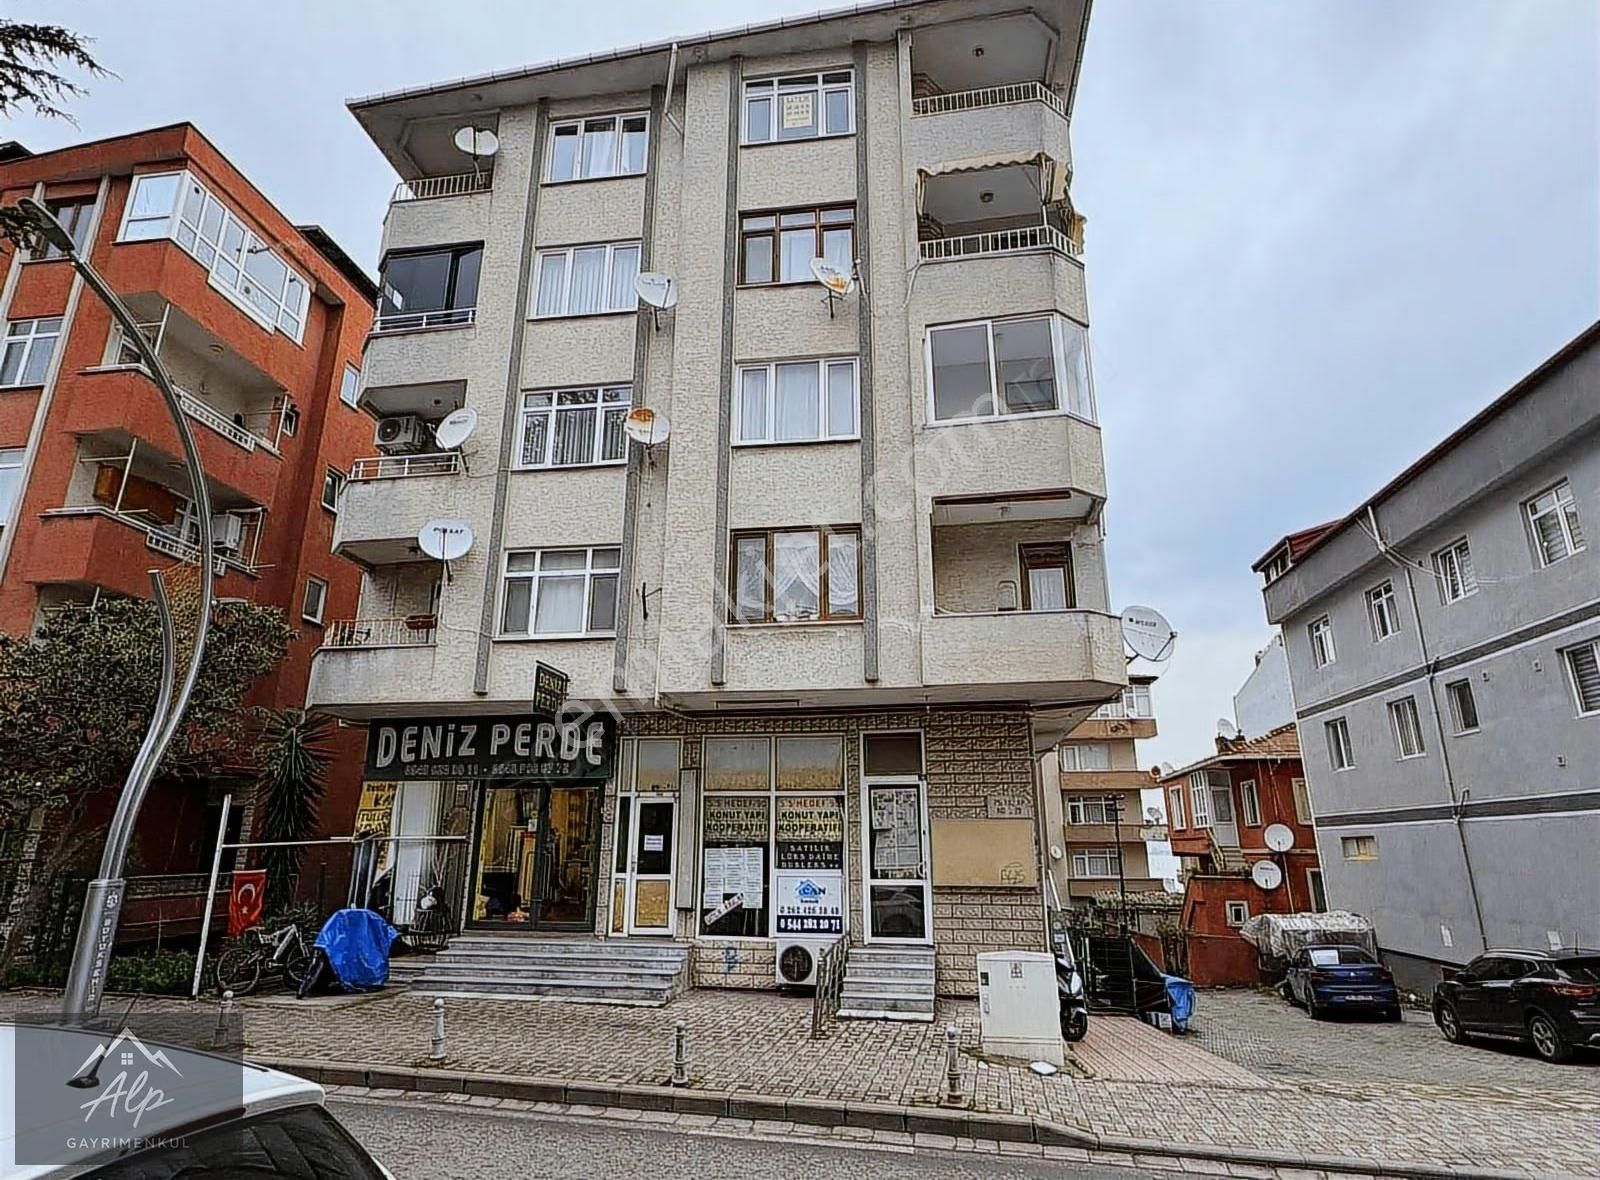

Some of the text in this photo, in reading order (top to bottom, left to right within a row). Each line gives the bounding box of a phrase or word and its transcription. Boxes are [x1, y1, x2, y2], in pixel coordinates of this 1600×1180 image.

[490, 722, 603, 766] PERDE
[709, 811, 766, 820] KONUT YAPI
[781, 811, 839, 820] KONUT YAPI
[780, 918, 785, 929] 0
[787, 918, 802, 931] 544
[831, 919, 840, 931] 71
